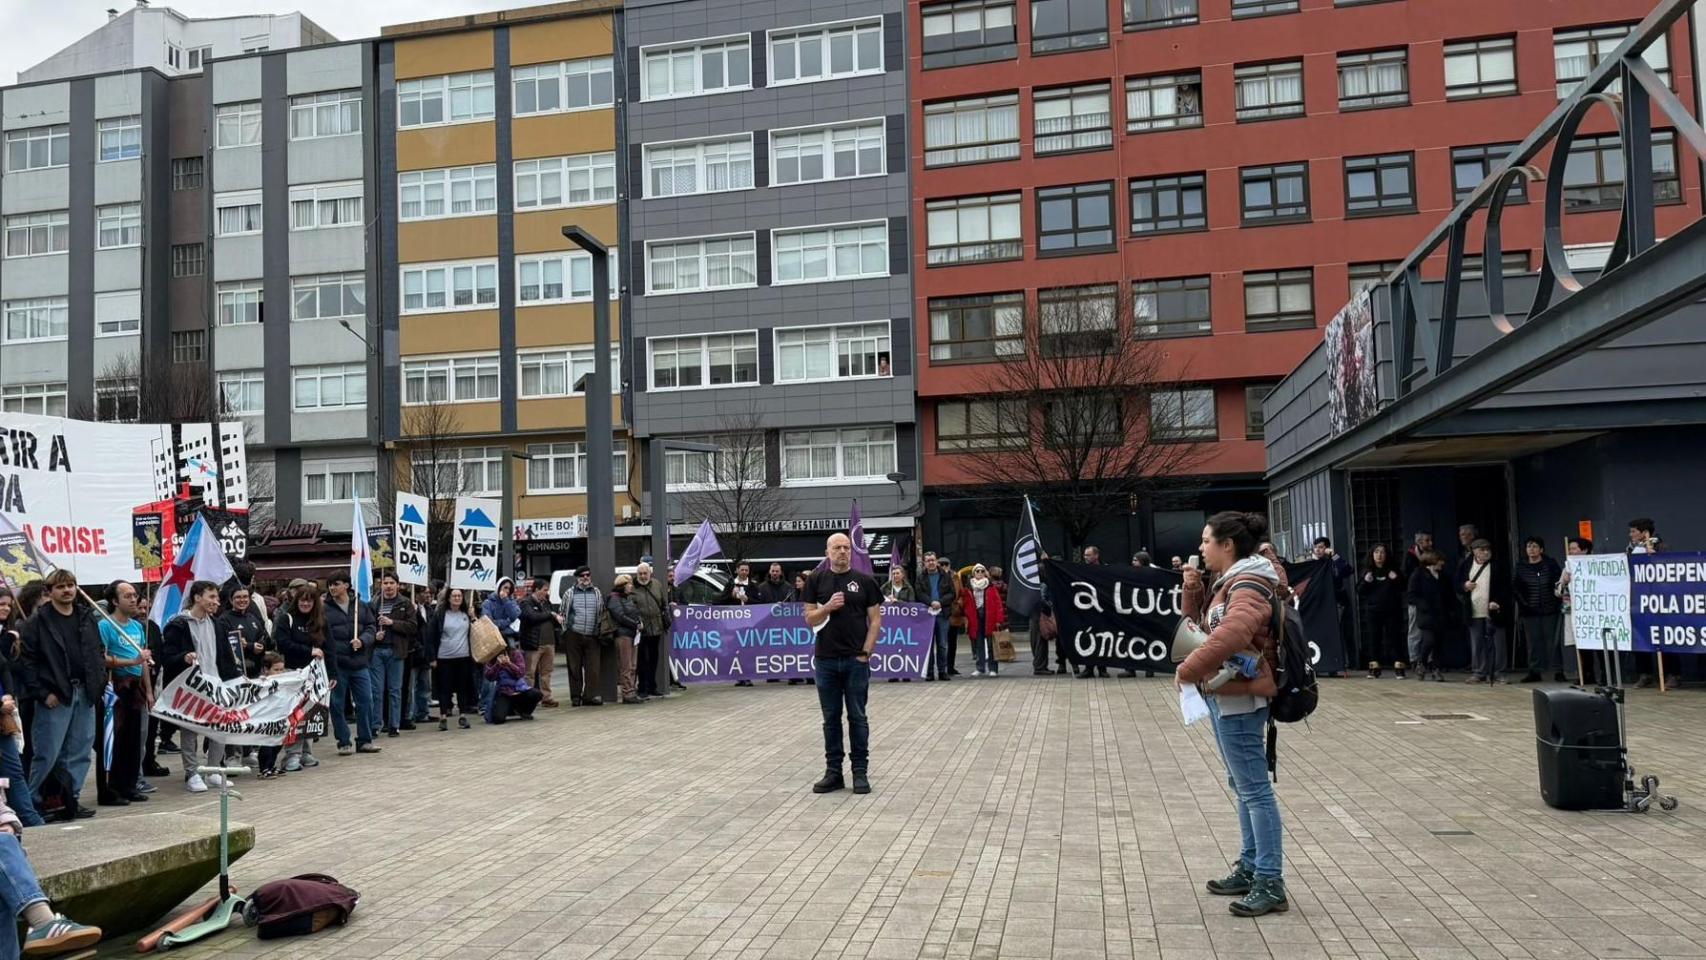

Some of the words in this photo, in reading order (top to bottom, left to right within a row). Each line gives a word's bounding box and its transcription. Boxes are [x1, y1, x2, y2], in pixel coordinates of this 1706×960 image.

[49, 434, 72, 472] A
[0, 473, 26, 514] A
[399, 522, 412, 537] VI
[533, 521, 553, 531] THE
[41, 525, 108, 555] CRISE
[458, 528, 478, 542] VI
[220, 537, 246, 558] ng
[399, 536, 426, 553] VEN
[457, 542, 496, 557] VEN
[527, 542, 570, 551] GIMNASIO
[399, 551, 420, 566] DA
[455, 557, 484, 571] DA
[1574, 560, 1583, 575] A
[1587, 559, 1627, 576] VIVENDA
[1574, 592, 1627, 612] DEREITO
[1640, 594, 1680, 614] POLA
[1683, 594, 1706, 614] DE
[686, 607, 751, 619] Podemos
[1599, 614, 1625, 628] PARA
[673, 625, 722, 649] MÁIS
[1650, 626, 1660, 645] E
[1664, 626, 1696, 646] DOS
[673, 657, 718, 677] NON
[729, 650, 743, 675] Á
[306, 720, 324, 736] bng
